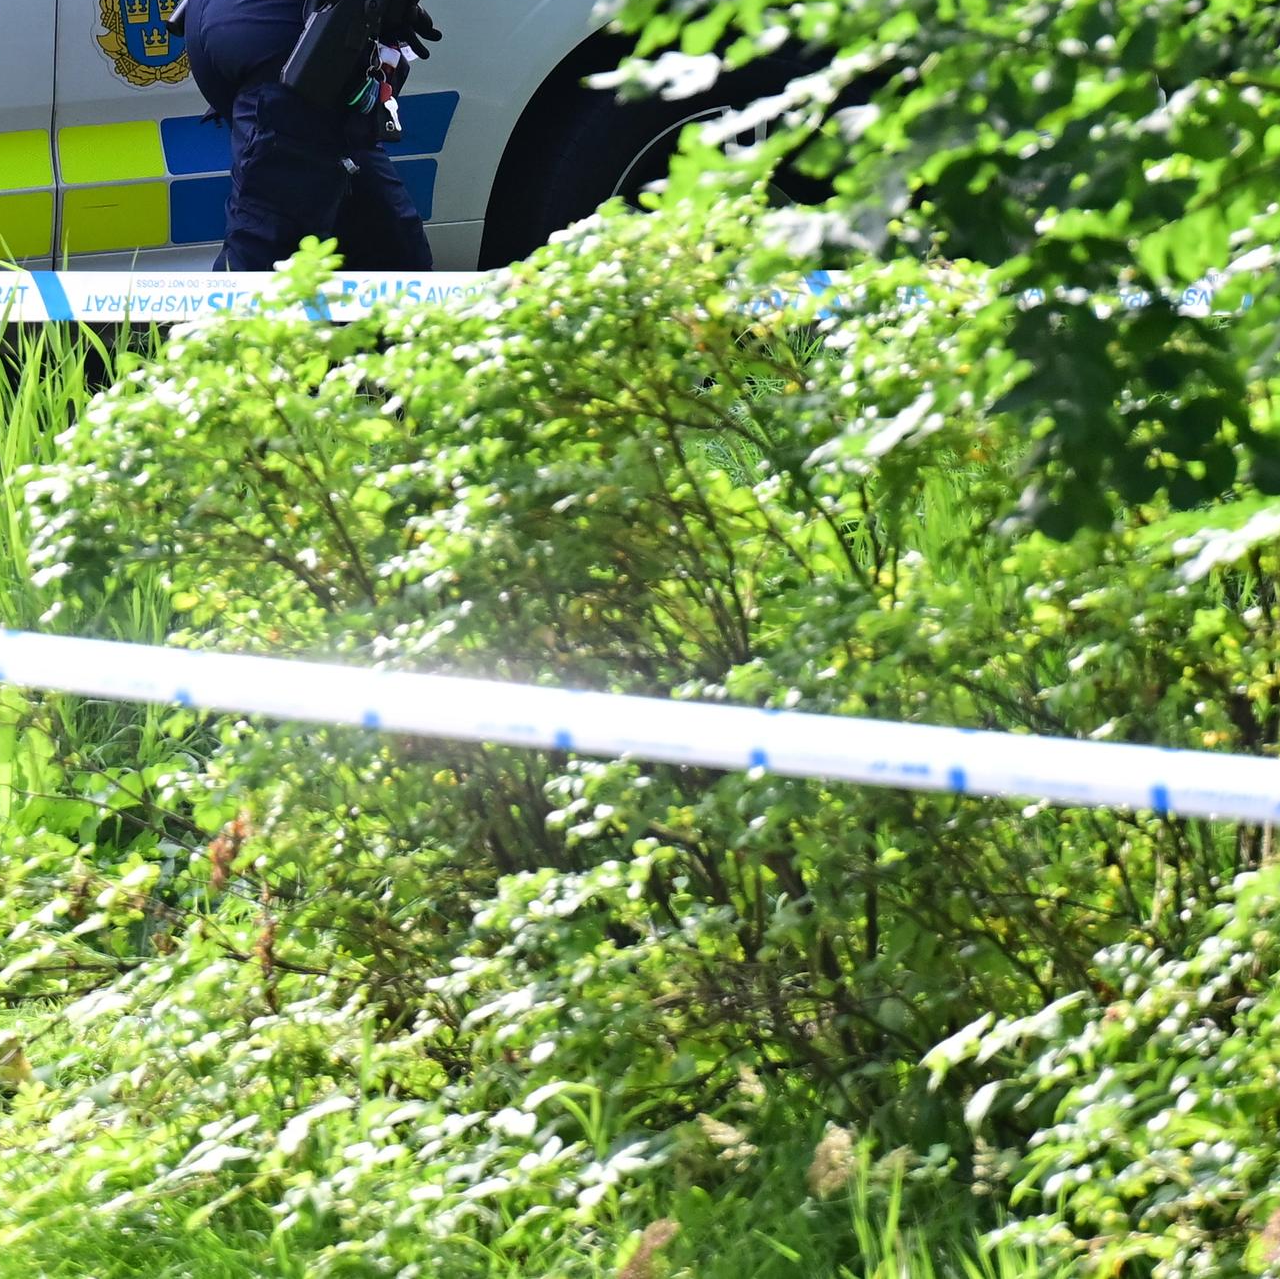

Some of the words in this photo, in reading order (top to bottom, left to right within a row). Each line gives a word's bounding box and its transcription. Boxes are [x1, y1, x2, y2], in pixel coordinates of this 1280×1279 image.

[136, 279, 166, 289] CROSS
[168, 279, 185, 288] NOT
[187, 279, 200, 288] DO
[207, 279, 237, 288] POLICE
